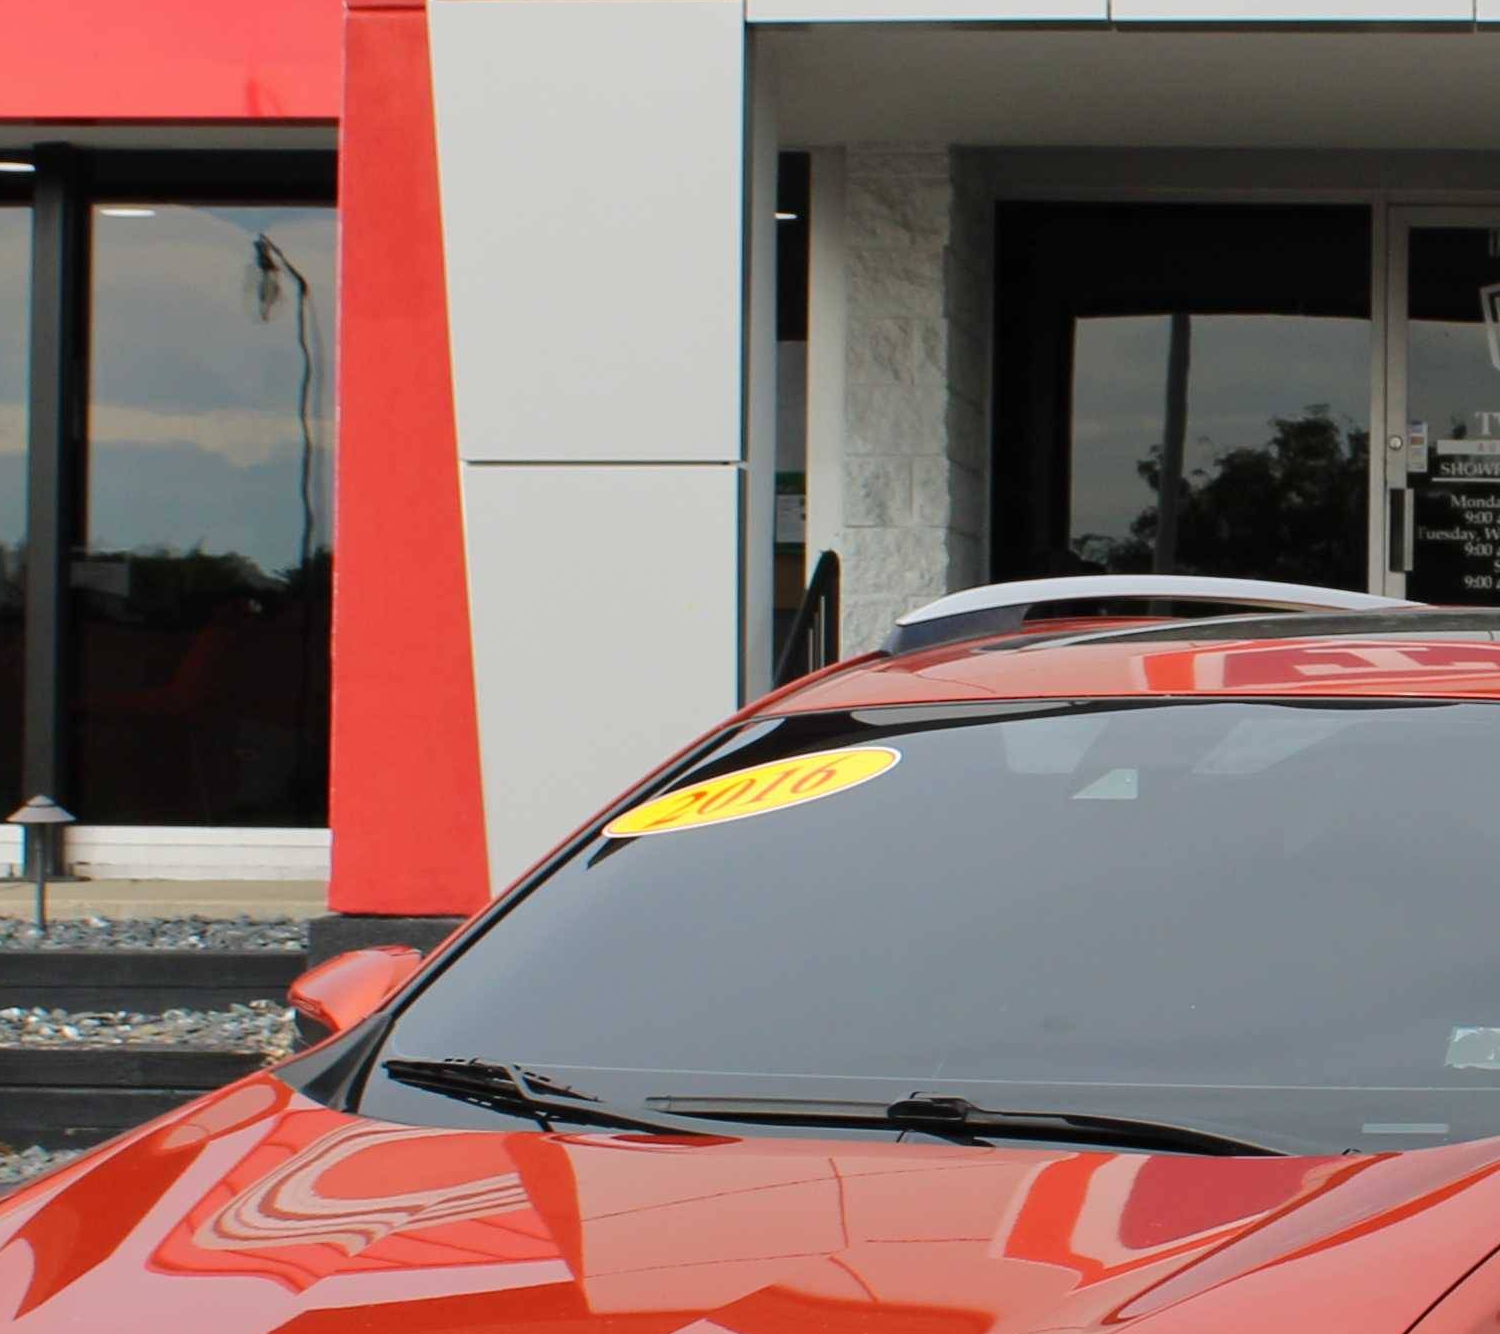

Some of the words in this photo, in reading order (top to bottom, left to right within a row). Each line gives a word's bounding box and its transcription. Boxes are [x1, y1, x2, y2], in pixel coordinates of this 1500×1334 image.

[1465, 511, 1493, 525] 9:00
[1418, 527, 1481, 543] Tuesday,
[1464, 543, 1493, 557] 9:00
[1464, 575, 1493, 589] 9:00
[642, 755, 852, 828] 2016
